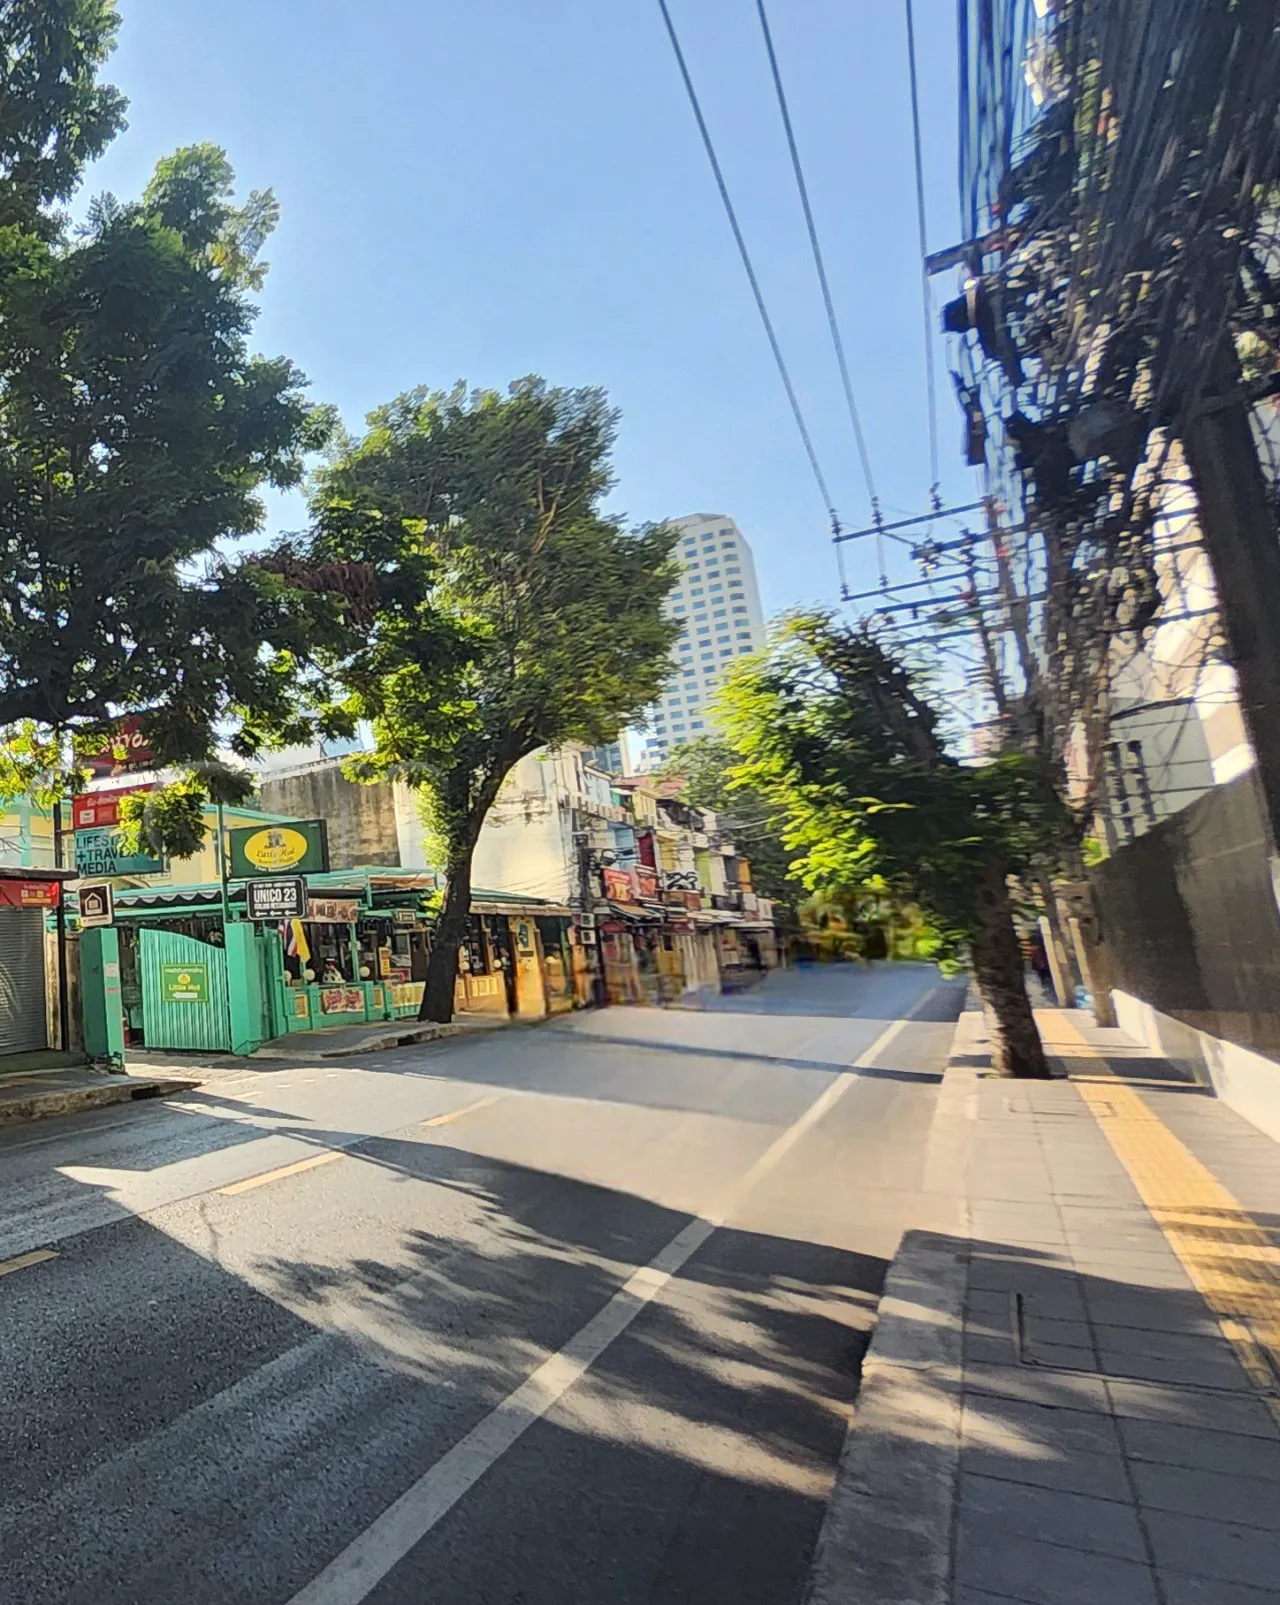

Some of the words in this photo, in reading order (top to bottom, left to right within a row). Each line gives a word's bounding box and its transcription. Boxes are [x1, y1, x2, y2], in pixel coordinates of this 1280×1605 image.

[77, 861, 117, 876] MEDIA
[253, 888, 283, 904] UNICO
[283, 887, 297, 902] 23
